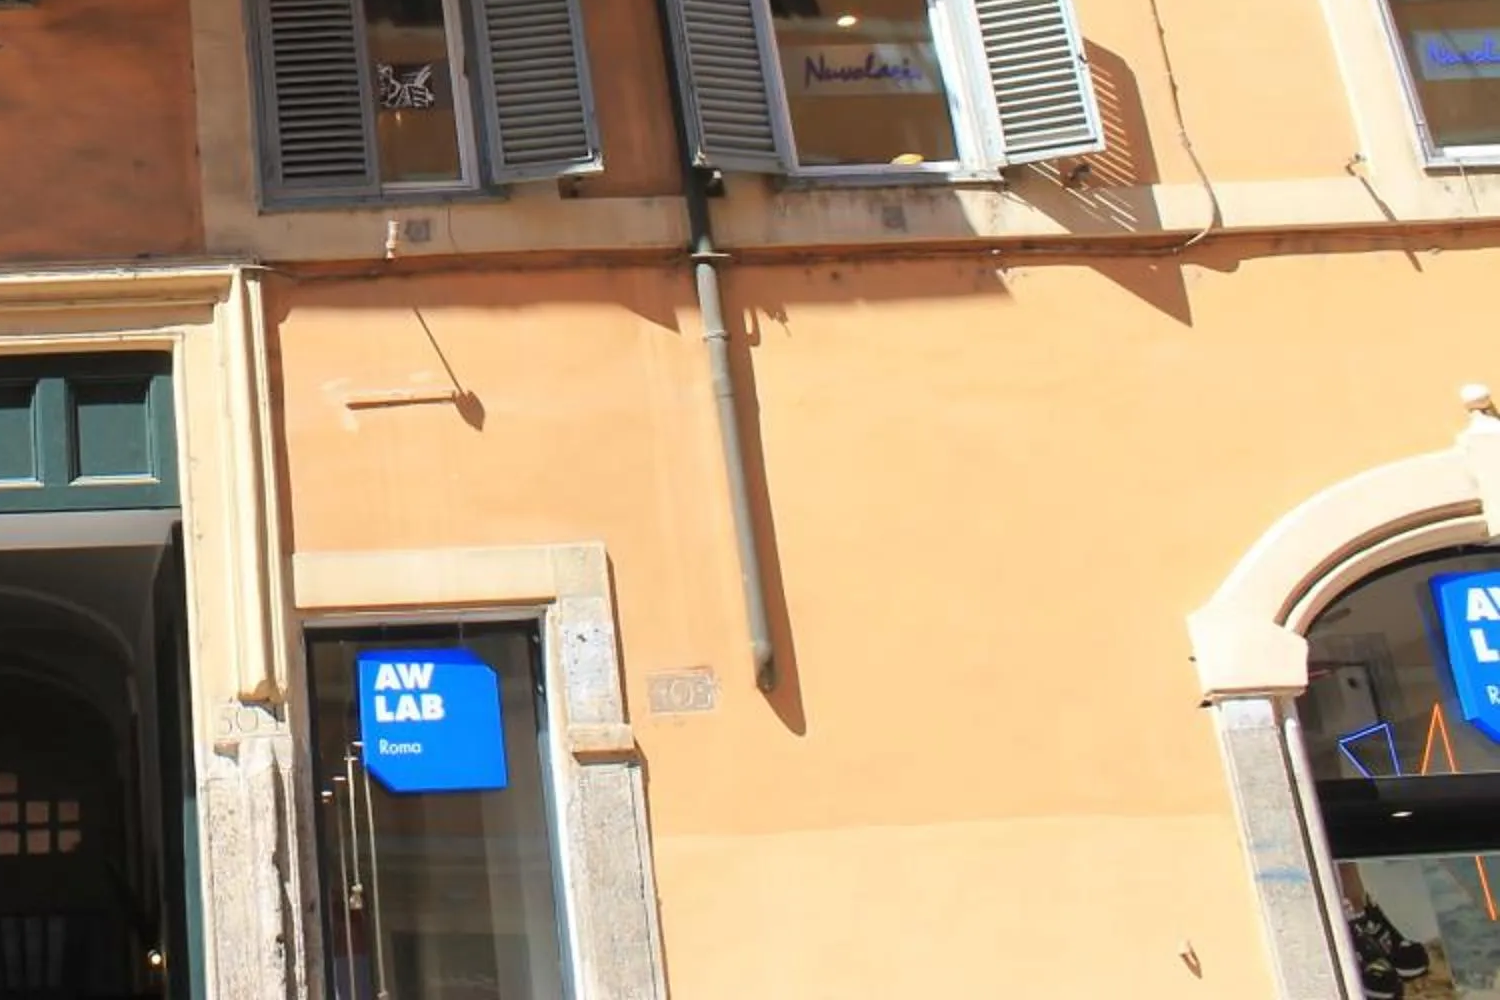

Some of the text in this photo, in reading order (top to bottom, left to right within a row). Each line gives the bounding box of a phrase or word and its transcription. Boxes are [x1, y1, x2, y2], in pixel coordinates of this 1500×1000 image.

[374, 662, 435, 691] AW
[374, 693, 445, 722] LAB
[379, 738, 422, 755] Roma
